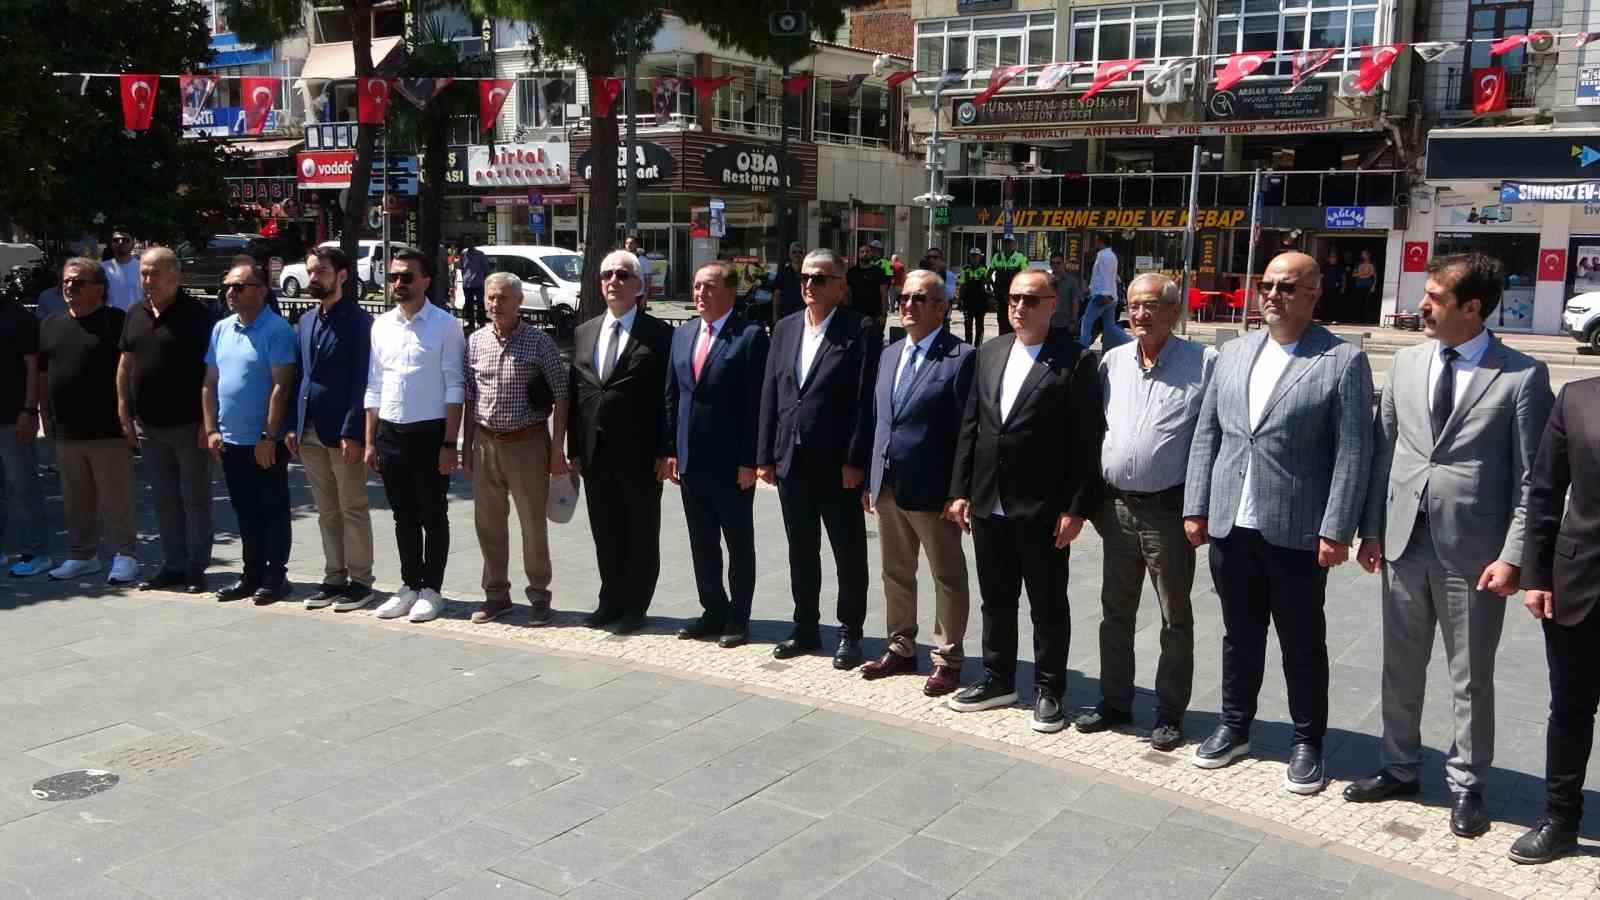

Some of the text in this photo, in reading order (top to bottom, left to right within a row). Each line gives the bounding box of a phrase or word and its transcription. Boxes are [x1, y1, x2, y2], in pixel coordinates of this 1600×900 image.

[1016, 99, 1056, 112] METAL
[1219, 124, 1256, 134] KEBAP
[722, 168, 791, 187] Restaurat
[1519, 184, 1600, 200] SINIRSIZ EV-
[1041, 208, 1100, 227] TERME
[1151, 209, 1175, 227] VE
